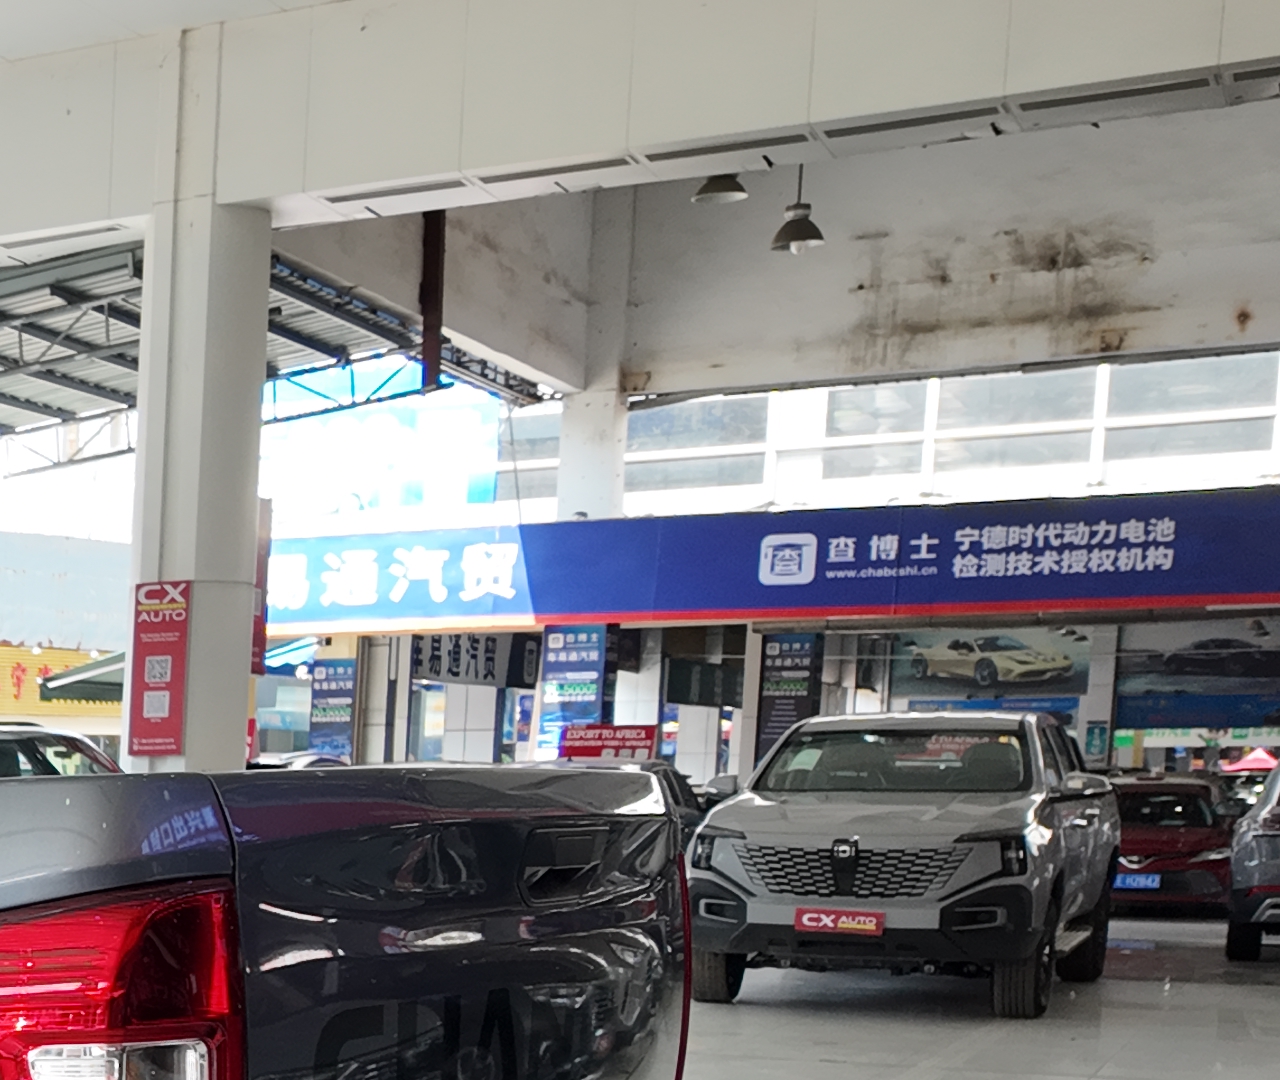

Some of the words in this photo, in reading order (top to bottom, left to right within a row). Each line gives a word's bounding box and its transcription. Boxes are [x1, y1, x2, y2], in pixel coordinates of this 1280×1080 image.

[954, 516, 1177, 552] 宁德时代动力电池
[826, 531, 940, 563] 查博士
[951, 544, 1175, 579] 检测技术授权机构
[137, 582, 188, 605] CX
[137, 608, 187, 624] AUTO
[566, 729, 601, 739] EXPORT
[601, 729, 614, 739] TO
[614, 729, 647, 739] AFRICA
[800, 911, 836, 928] CX
[837, 914, 878, 927] AUTO
